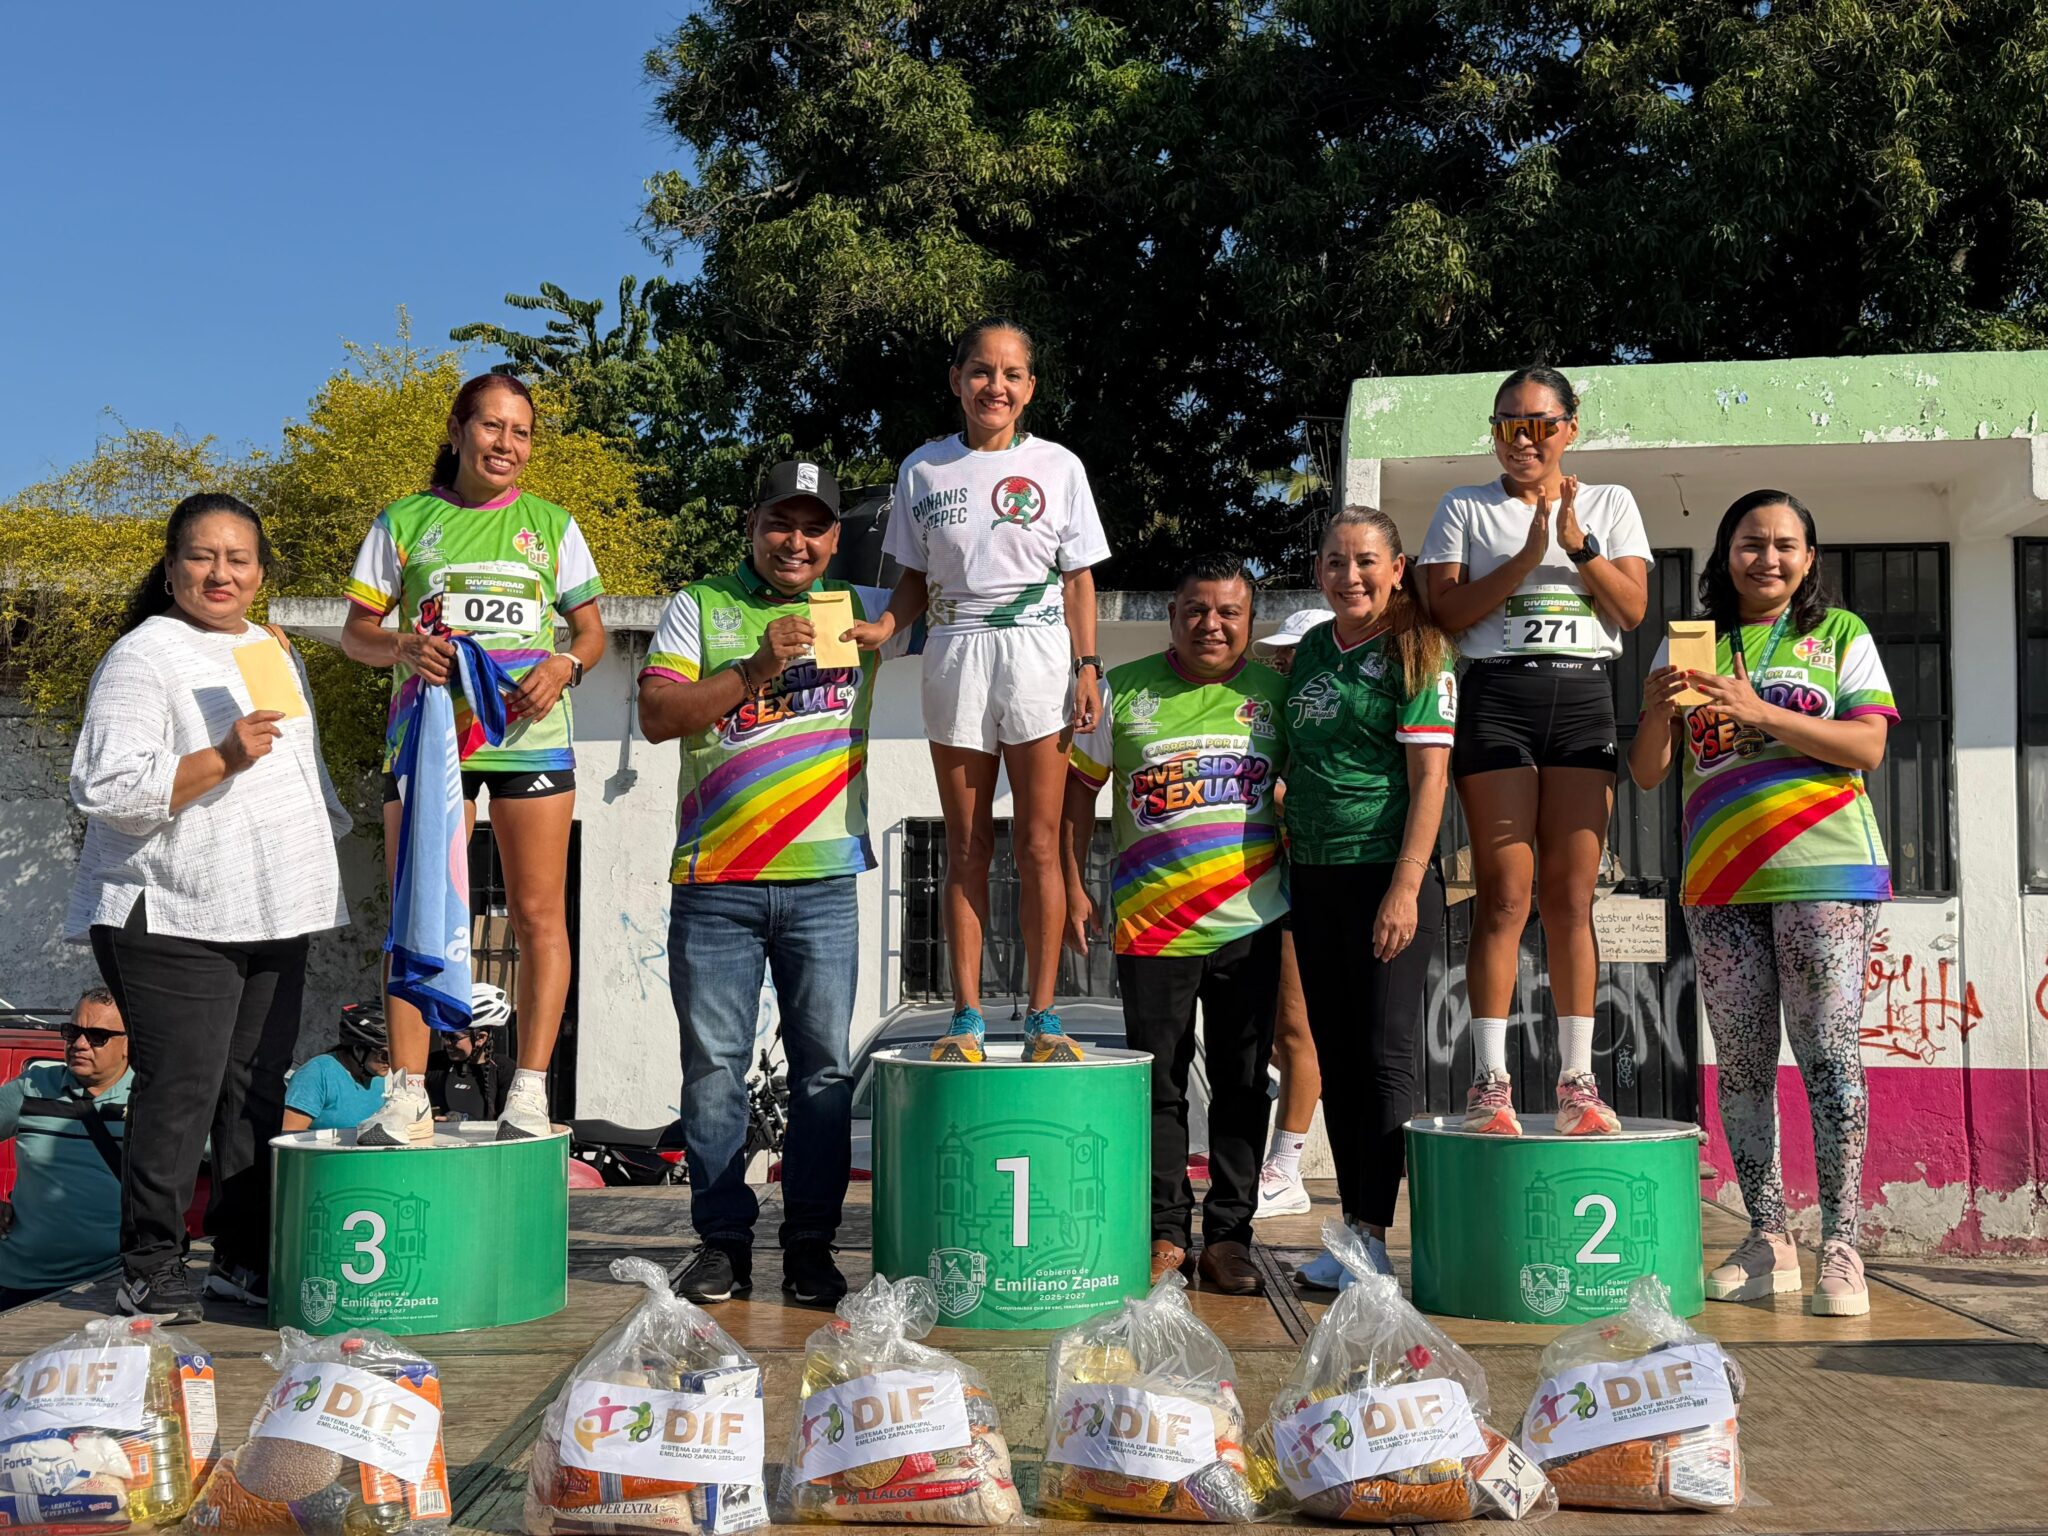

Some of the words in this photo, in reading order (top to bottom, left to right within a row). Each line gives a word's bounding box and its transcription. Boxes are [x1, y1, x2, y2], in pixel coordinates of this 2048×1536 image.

[530, 551, 548, 563] DIF
[465, 579, 525, 590] DIVERSIDAD
[465, 598, 524, 625] 026
[1523, 600, 1581, 608] DIVERSIDAD
[1524, 620, 1577, 644] 271
[1551, 661, 1584, 669] TECHFIT
[1811, 656, 1834, 665] DIF
[1785, 670, 1803, 679] LA
[739, 685, 844, 727] SEXUAL
[1253, 722, 1275, 735] DIF
[1145, 739, 1203, 758] CARRERA
[1205, 738, 1231, 749] POR
[1233, 739, 1250, 750] LA
[1132, 757, 1266, 794] DIVERSIDAD
[1147, 777, 1260, 815] SEXUAL
[995, 1156, 1030, 1247] 1
[1573, 1194, 1621, 1264] 2
[341, 1210, 387, 1284] 3
[1036, 1268, 1077, 1277] Gobierno
[1079, 1267, 1089, 1275] de
[994, 1277, 1068, 1292] Emiliano
[1072, 1273, 1120, 1292] Zapata
[341, 1297, 392, 1308] Emiliano
[395, 1296, 439, 1309] Zapata
[1039, 1292, 1086, 1301] 2025-2027
[27, 1362, 117, 1399] DIF
[1603, 1361, 1693, 1409] DIF
[323, 1382, 416, 1437] DIF
[851, 1386, 934, 1433] DIF
[1612, 1406, 1641, 1417] SISTEMA
[1656, 1395, 1694, 1407] MUNICIPAL
[1613, 1411, 1647, 1422] EMILIANO
[1648, 1404, 1675, 1415] ZAPATA
[319, 1414, 349, 1428] SISTEMA
[349, 1424, 361, 1432] DIF
[1109, 1405, 1191, 1447] DIF
[1359, 1395, 1443, 1439] DIF
[316, 1420, 349, 1435] EMILIANO
[663, 1408, 744, 1446] DIF
[855, 1430, 883, 1440] SISTEMA
[884, 1426, 895, 1434] DIF
[896, 1421, 933, 1431] MUNICIPAL
[856, 1435, 886, 1447] EMILIANO
[888, 1430, 914, 1439] ZAPATA
[915, 1425, 946, 1434] 2025-2027
[660, 1444, 690, 1453] SISTEMA
[1368, 1436, 1398, 1447] SISTEMA
[1370, 1441, 1403, 1453] EMILIANO
[660, 1450, 692, 1459] EMILIANO
[1106, 1444, 1137, 1456] EMILIANO
[1138, 1450, 1163, 1460] ZAPATA
[1149, 1446, 1183, 1457] MUNICIPAL
[586, 1504, 622, 1514] SUPER
[622, 1503, 659, 1514] EXTRA
